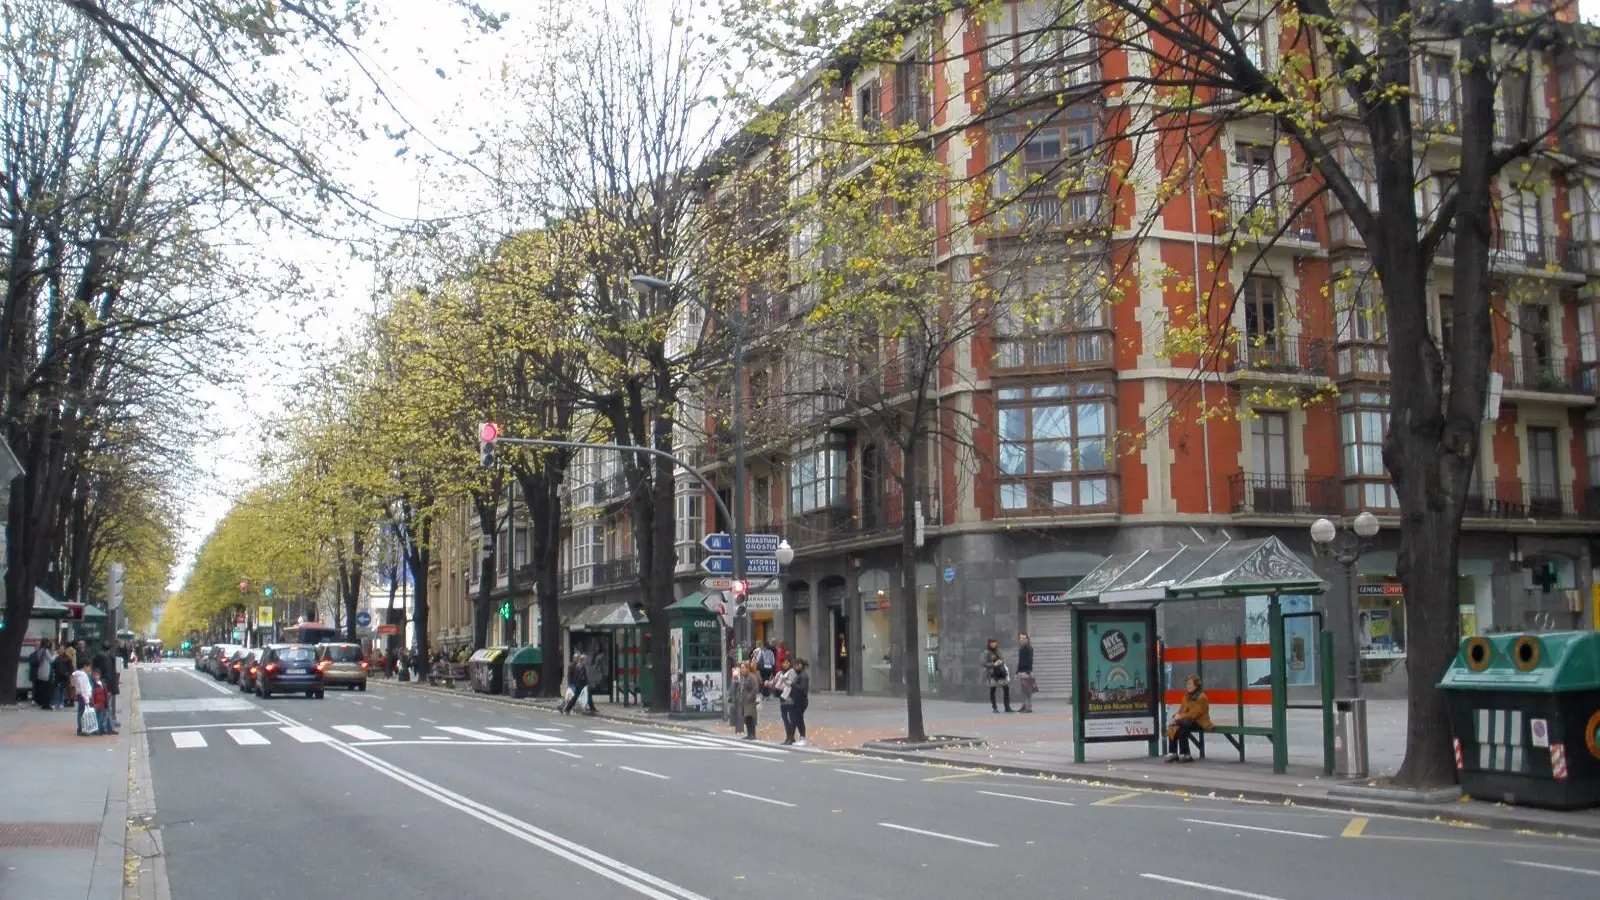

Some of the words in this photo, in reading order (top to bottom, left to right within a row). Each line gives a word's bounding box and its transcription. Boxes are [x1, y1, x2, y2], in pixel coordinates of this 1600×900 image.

[1031, 594, 1060, 602] GENERA
[694, 620, 717, 628] ONCE
[1102, 631, 1121, 648] NYC
[1124, 726, 1149, 736] Viva
